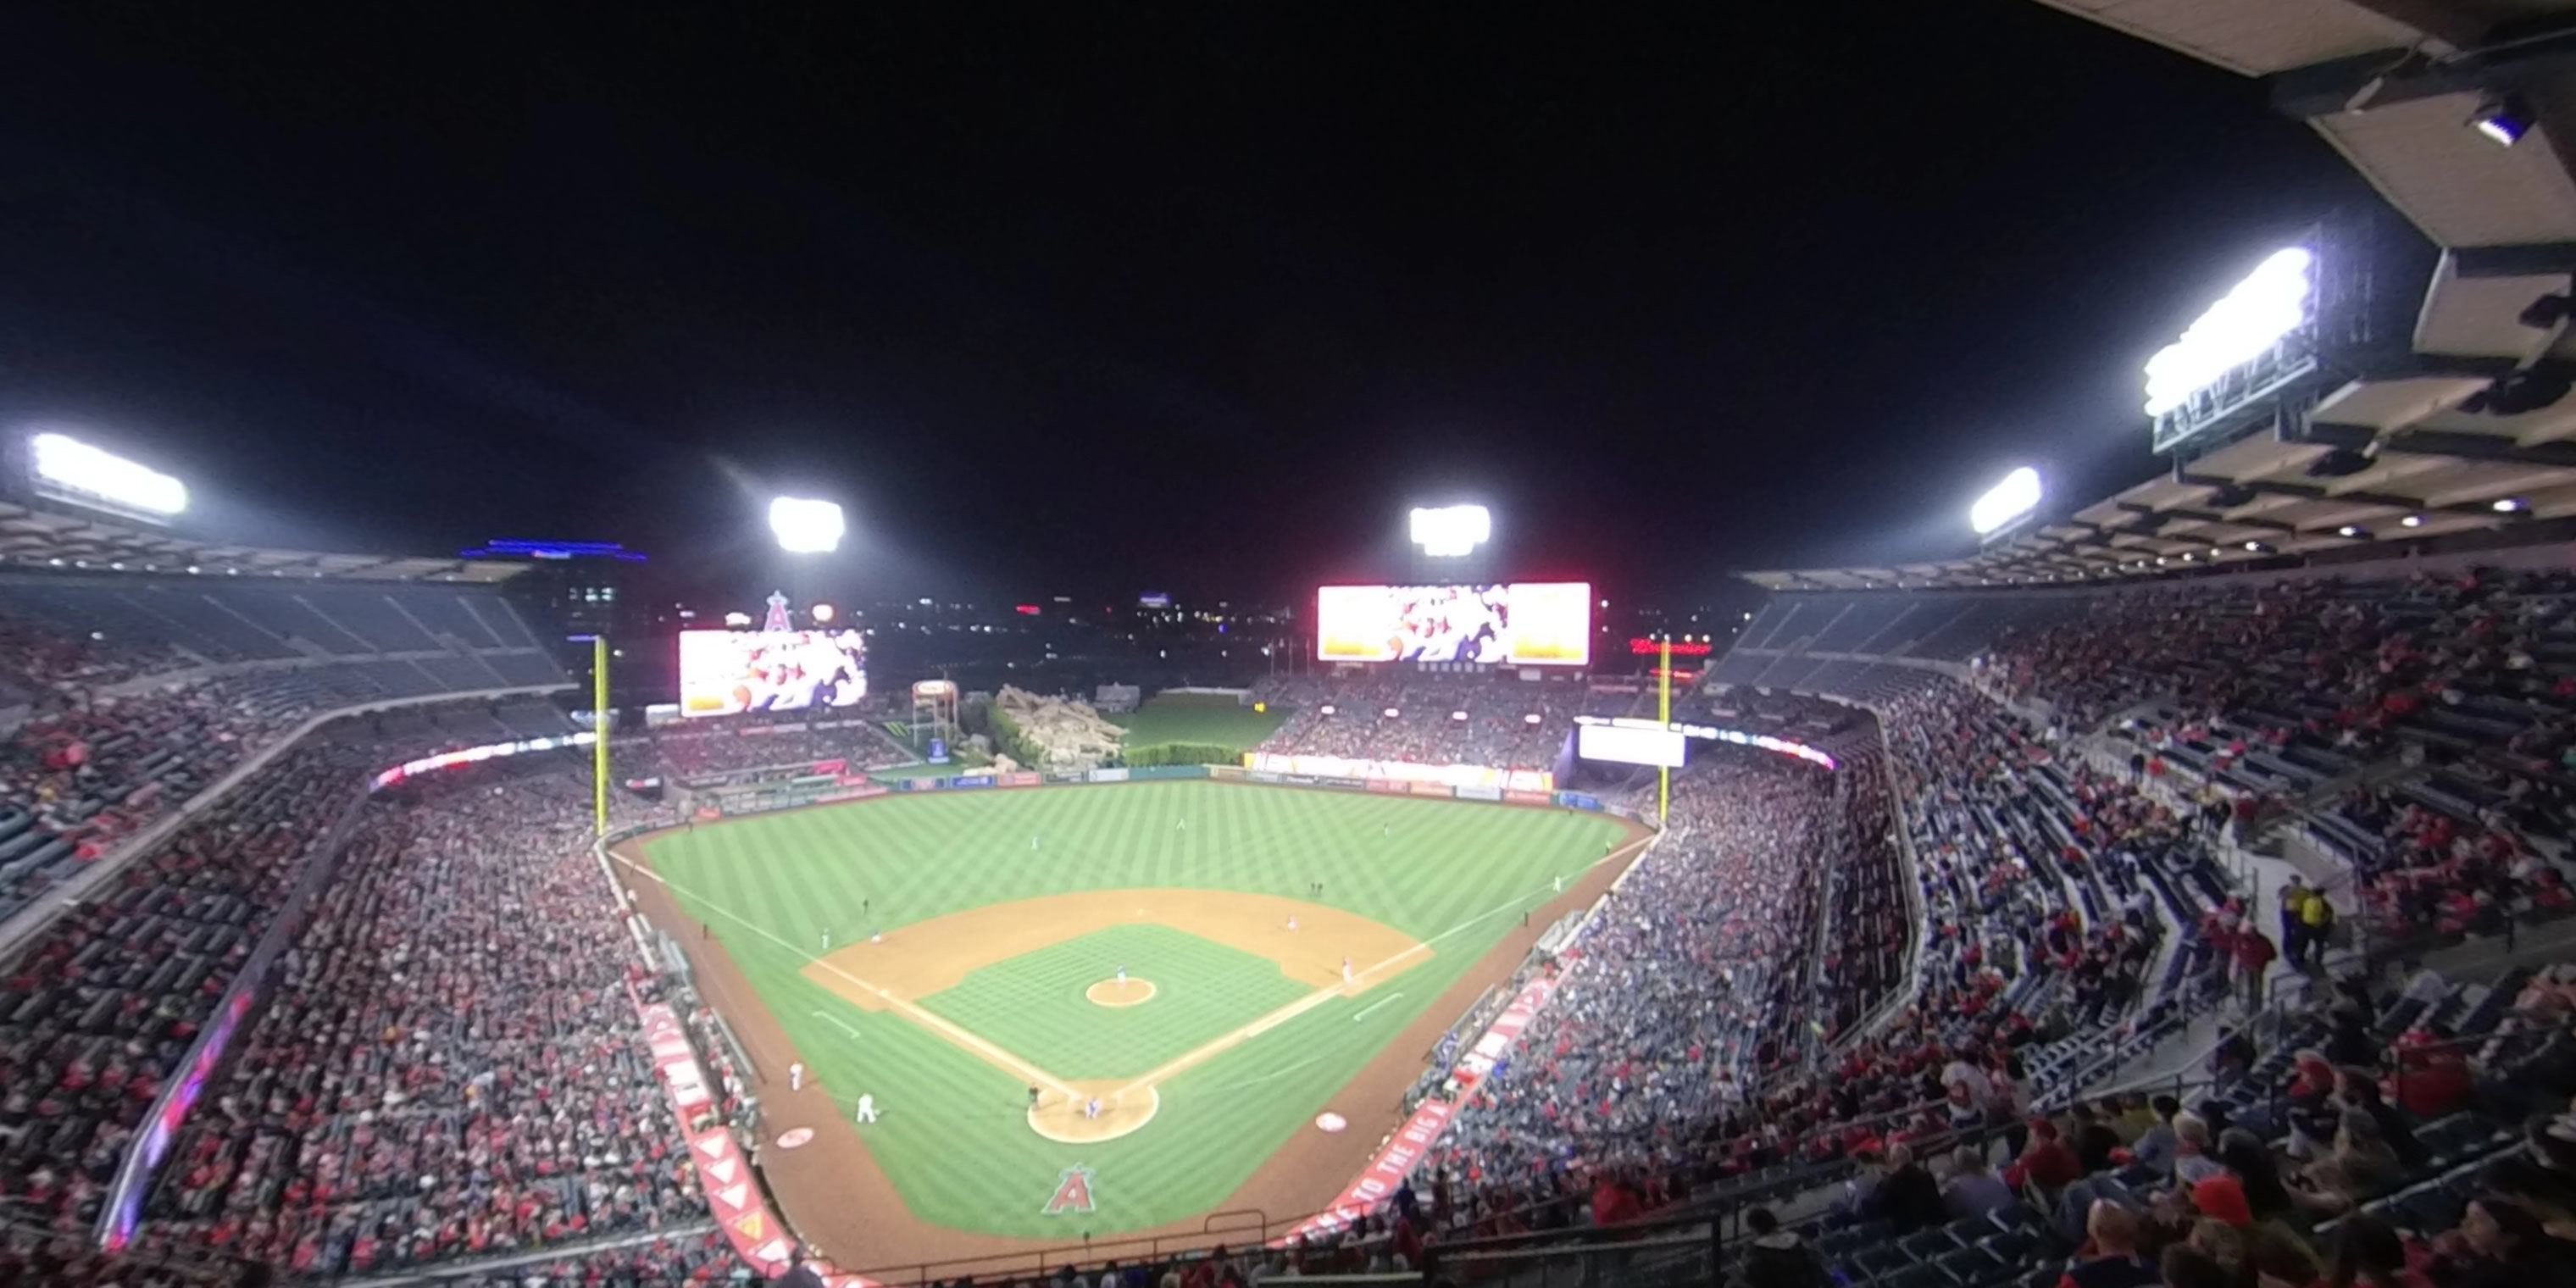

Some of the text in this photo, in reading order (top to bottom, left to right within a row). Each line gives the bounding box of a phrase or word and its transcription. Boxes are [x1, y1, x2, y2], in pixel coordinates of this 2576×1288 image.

[1041, 1162, 1096, 1214] A
[1352, 1104, 1449, 1201] TO THE BIG A
